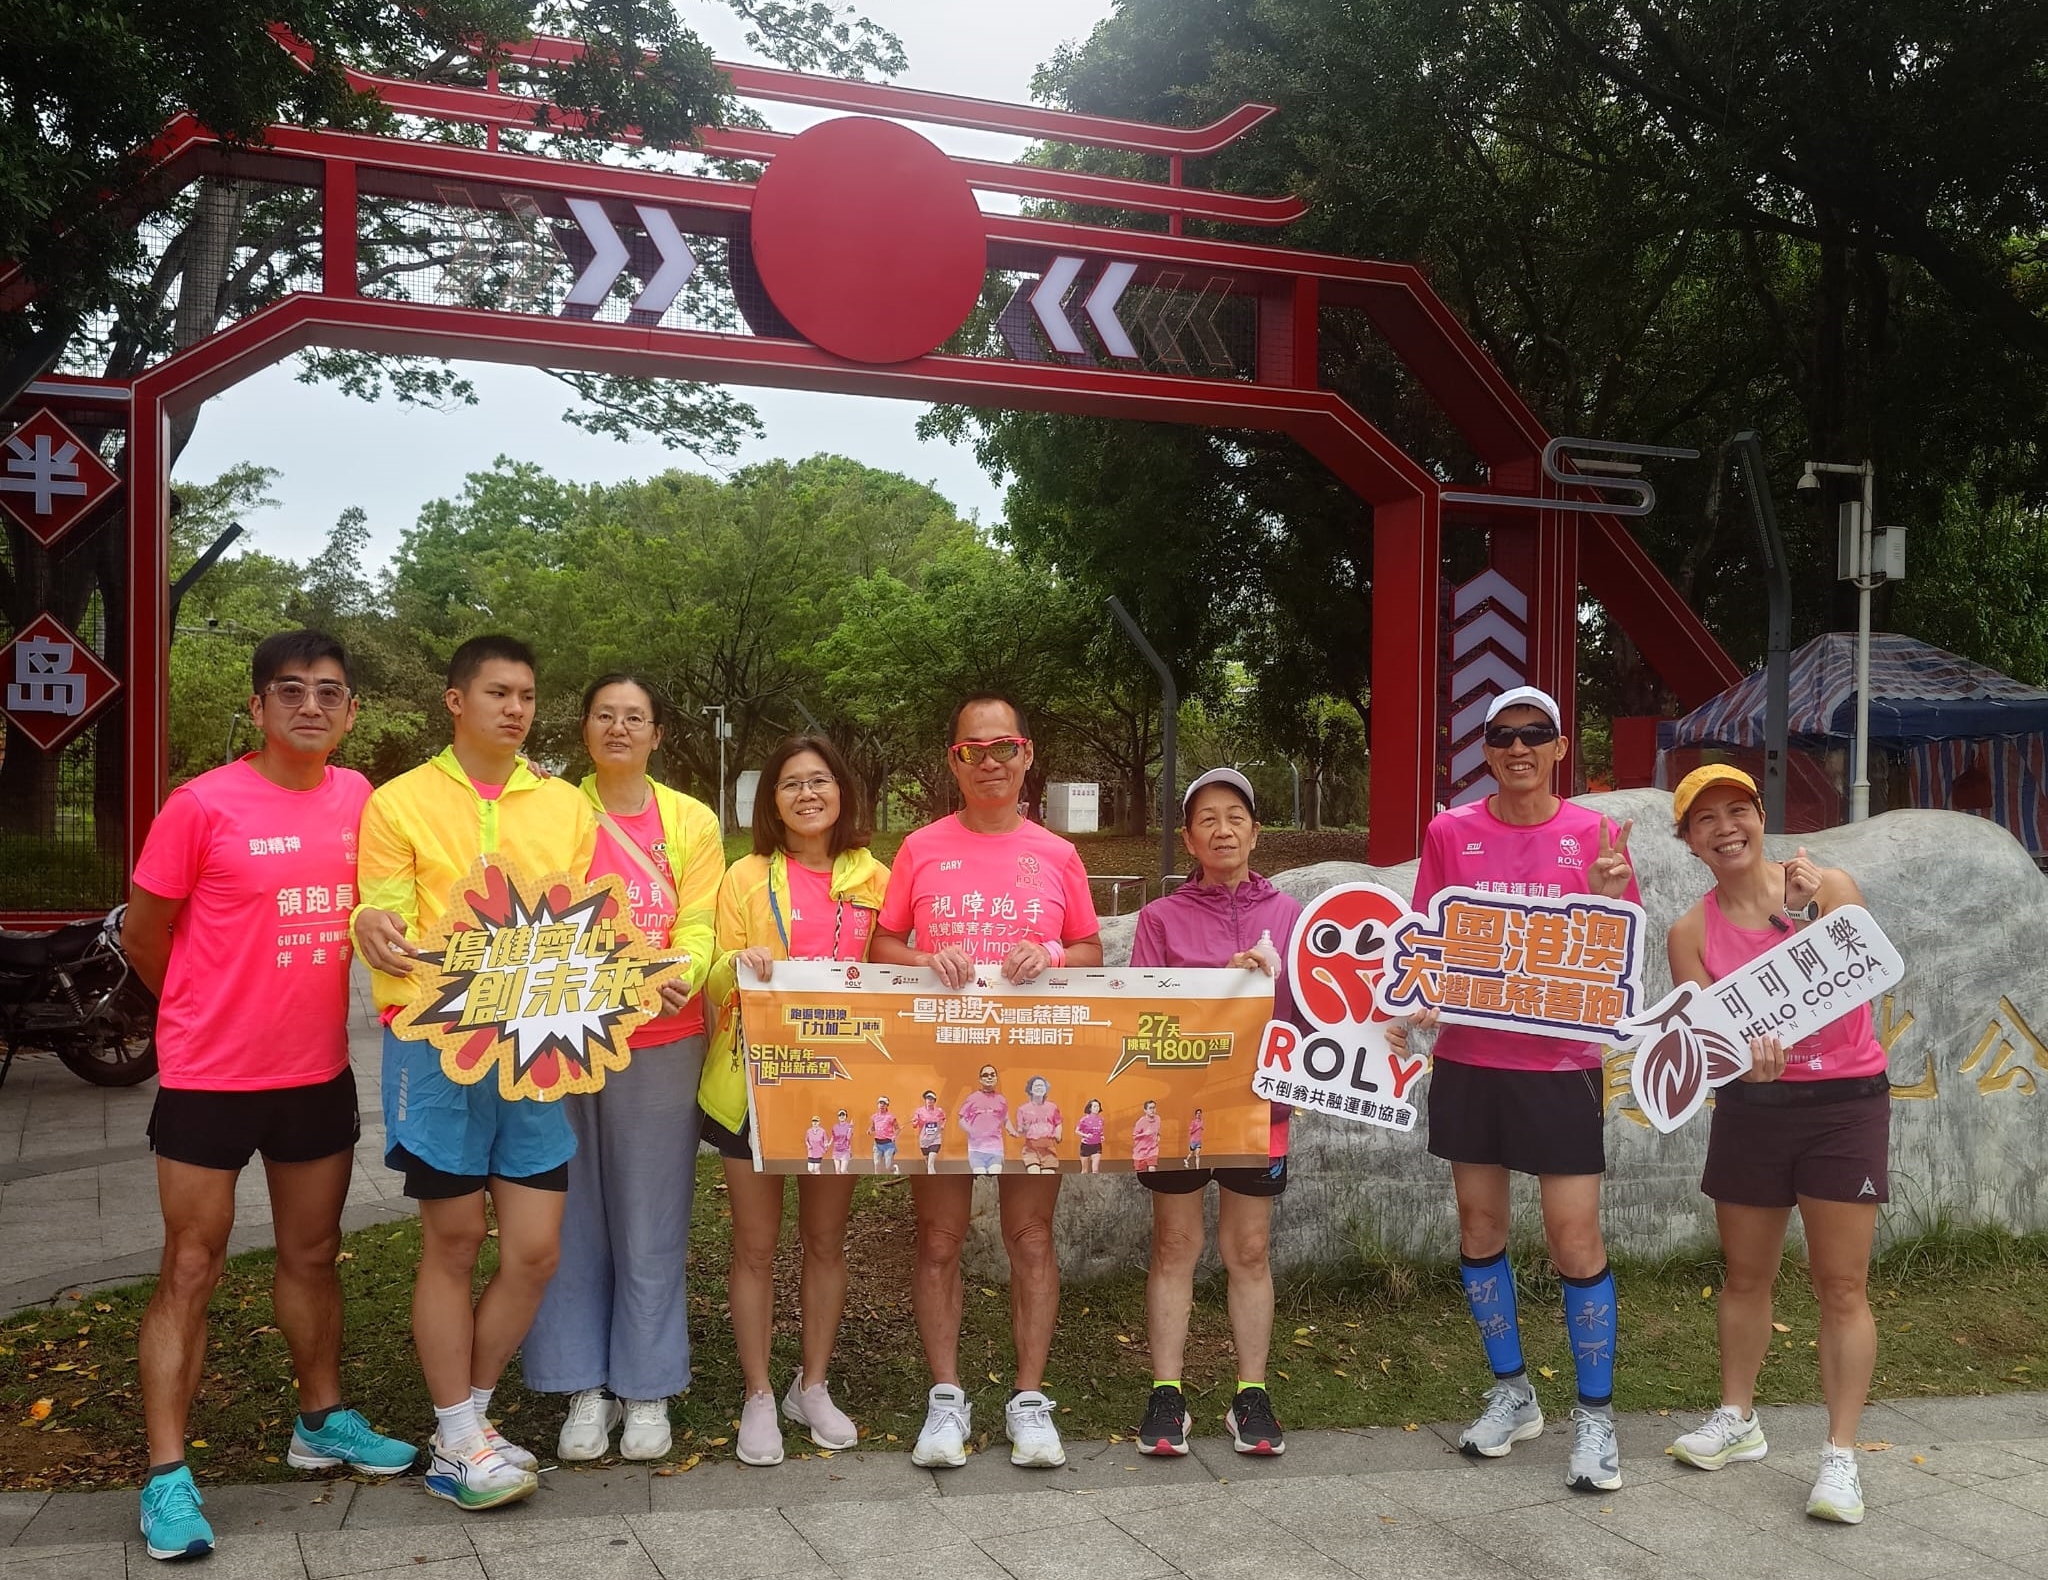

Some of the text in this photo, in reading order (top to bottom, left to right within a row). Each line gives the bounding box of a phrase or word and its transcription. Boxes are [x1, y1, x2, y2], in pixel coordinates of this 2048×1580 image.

[0, 435, 87, 515] 半
[7, 636, 87, 717] 岛
[249, 836, 301, 855] 勁精神
[940, 860, 962, 871] GARY
[1558, 857, 1583, 867] ROLY
[277, 883, 354, 917] 領跑員
[930, 890, 1045, 924] 視障跑手
[277, 933, 312, 947] GUIDE
[441, 918, 617, 973] 傷健齊心
[458, 958, 650, 1027] 創未來
[1393, 953, 1626, 1027] 大灣區慈善跑
[1714, 916, 1868, 1020] 可可阿樂
[1811, 1001, 1833, 1017] TO
[1844, 967, 1890, 998] LIFE
[1738, 955, 1883, 1045] HELLO COCOA
[936, 1026, 1074, 1045] 運動無界 共融同行
[761, 1061, 831, 1080] 跑出新希望
[1263, 1026, 1423, 1099] ROLY
[1258, 1076, 1412, 1126] 不倒翁共融運動協會
